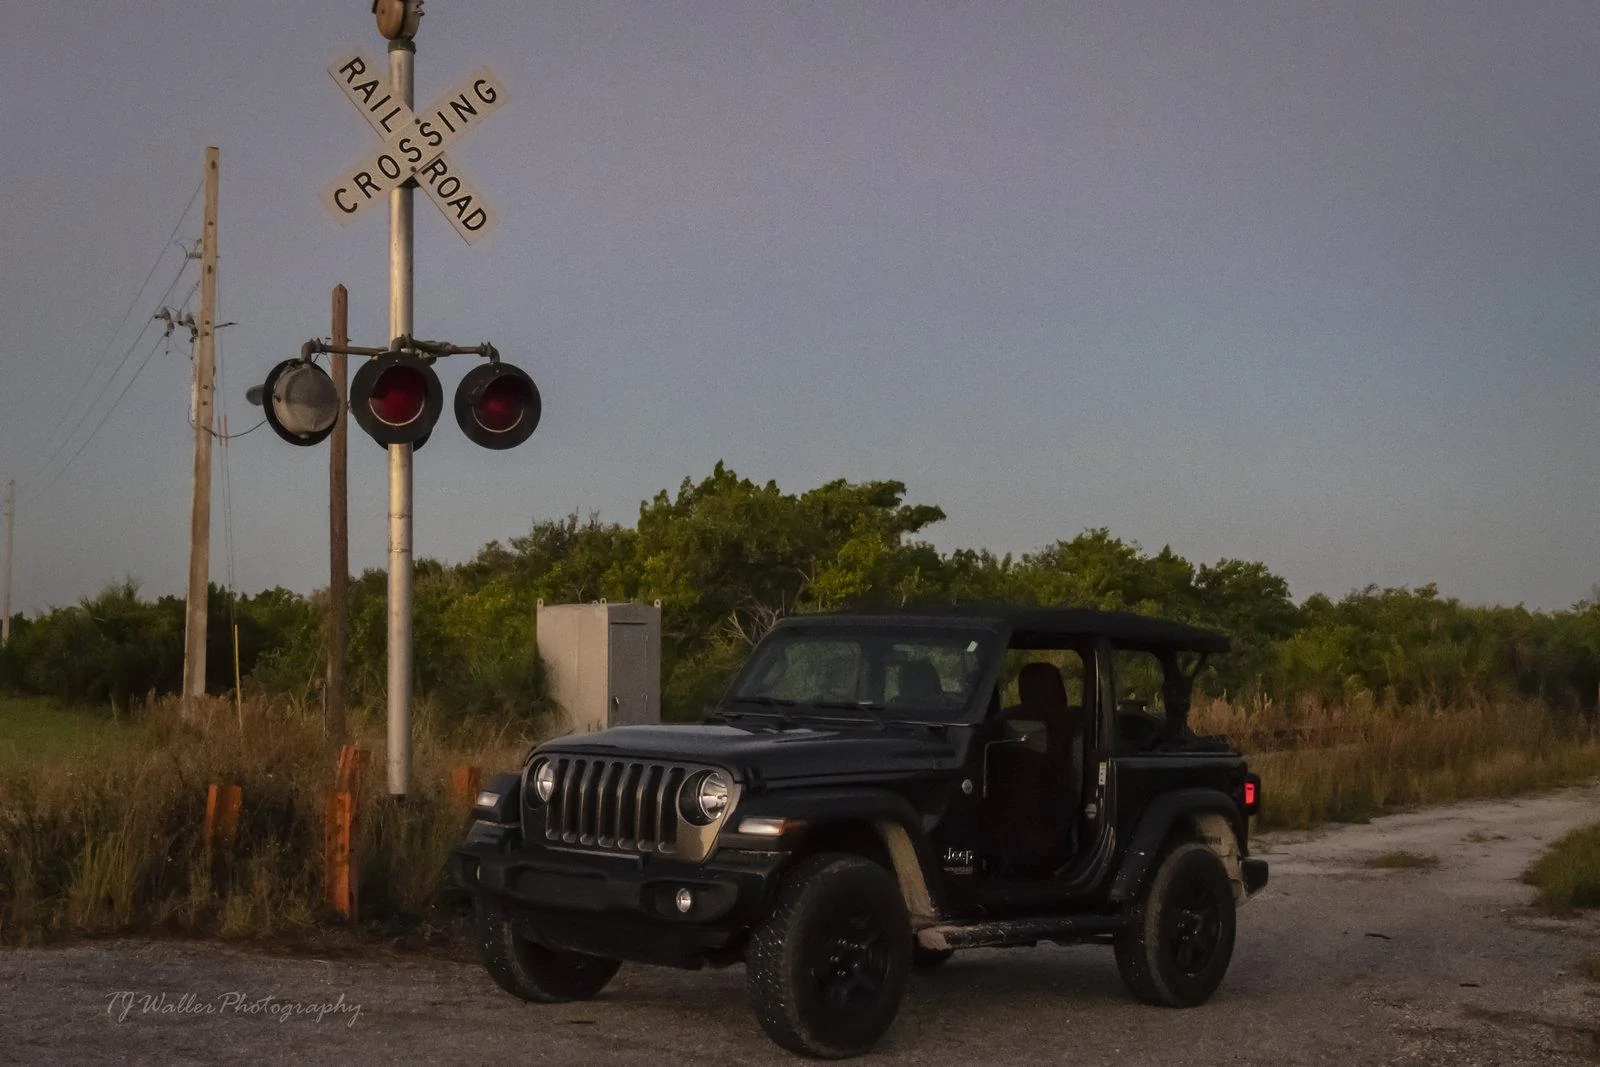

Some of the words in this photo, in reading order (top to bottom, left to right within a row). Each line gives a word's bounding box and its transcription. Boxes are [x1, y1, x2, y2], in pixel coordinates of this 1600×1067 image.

[334, 79, 498, 214] CROSSING
[339, 56, 402, 133] RAIL
[421, 158, 487, 231] ROAD
[943, 847, 974, 865] Jeep
